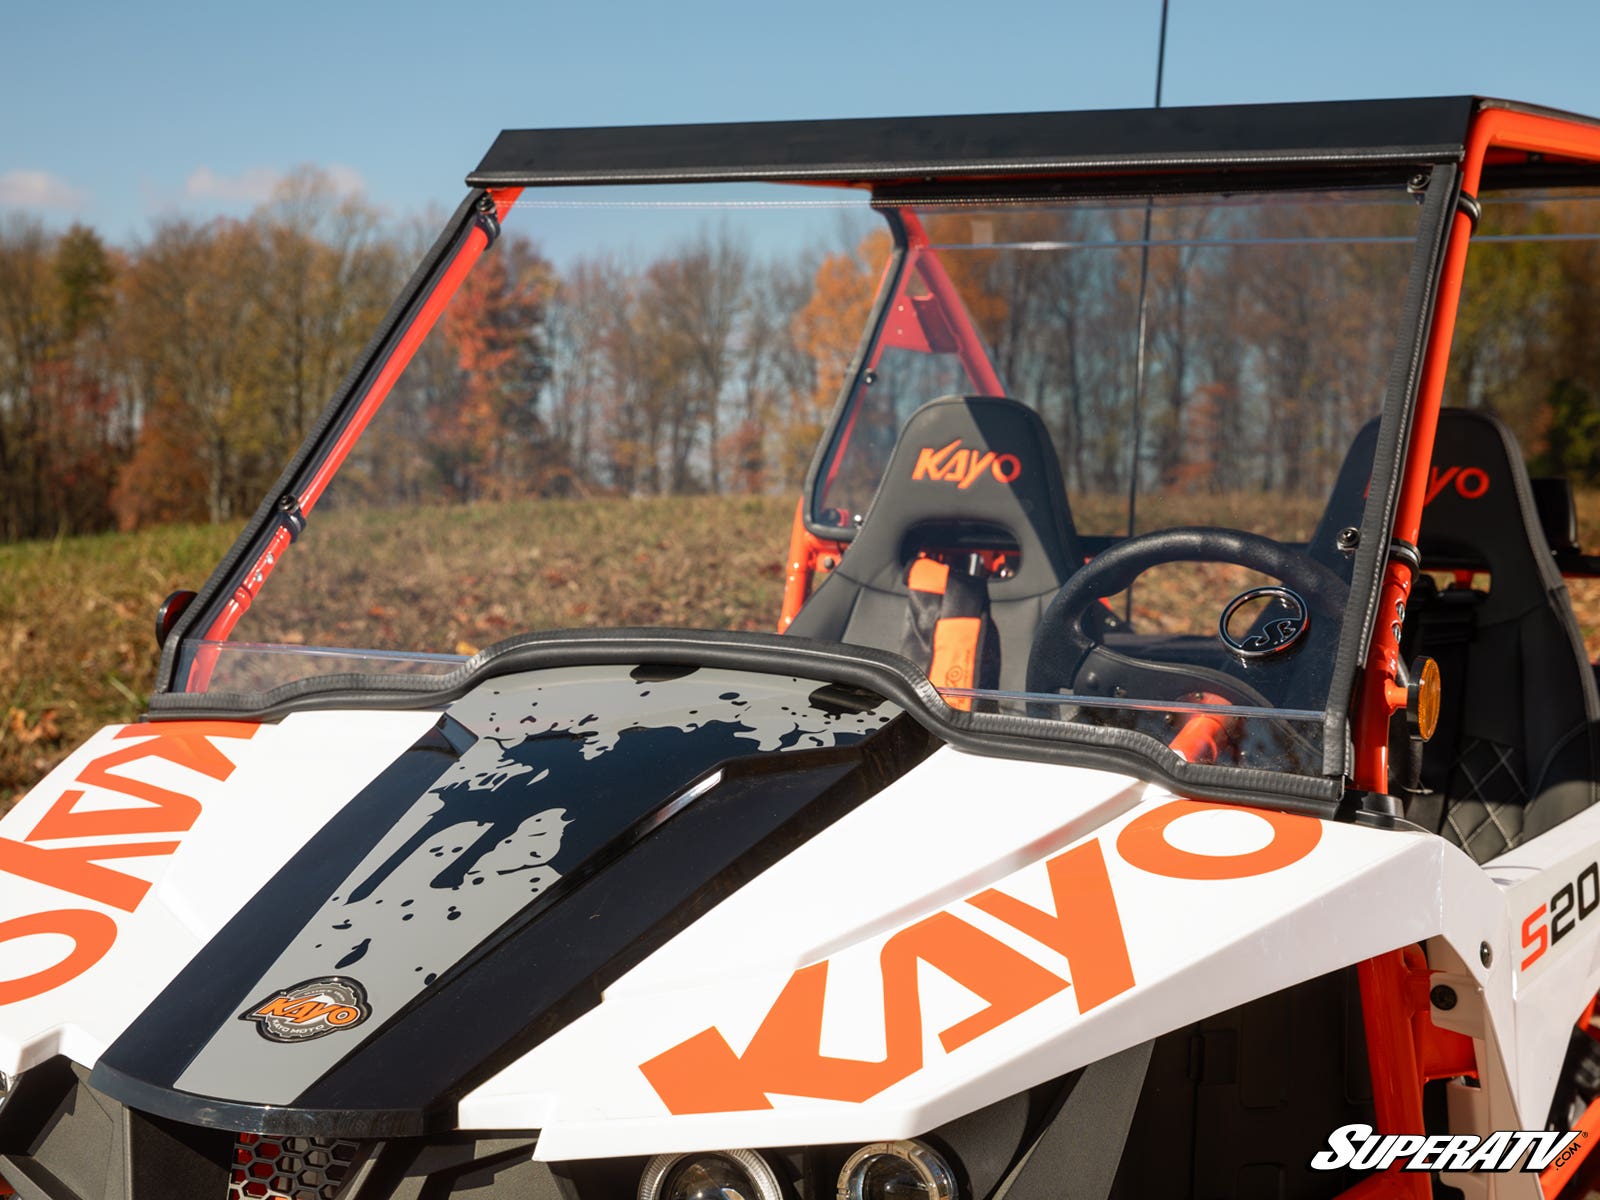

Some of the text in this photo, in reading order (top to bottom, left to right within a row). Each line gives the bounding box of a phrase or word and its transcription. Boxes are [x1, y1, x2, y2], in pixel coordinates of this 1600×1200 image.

[911, 439, 1022, 489] KAYO
[638, 799, 1322, 1115] KAYO
[252, 993, 361, 1027] KAYO
[290, 1024, 325, 1034] MOTO
